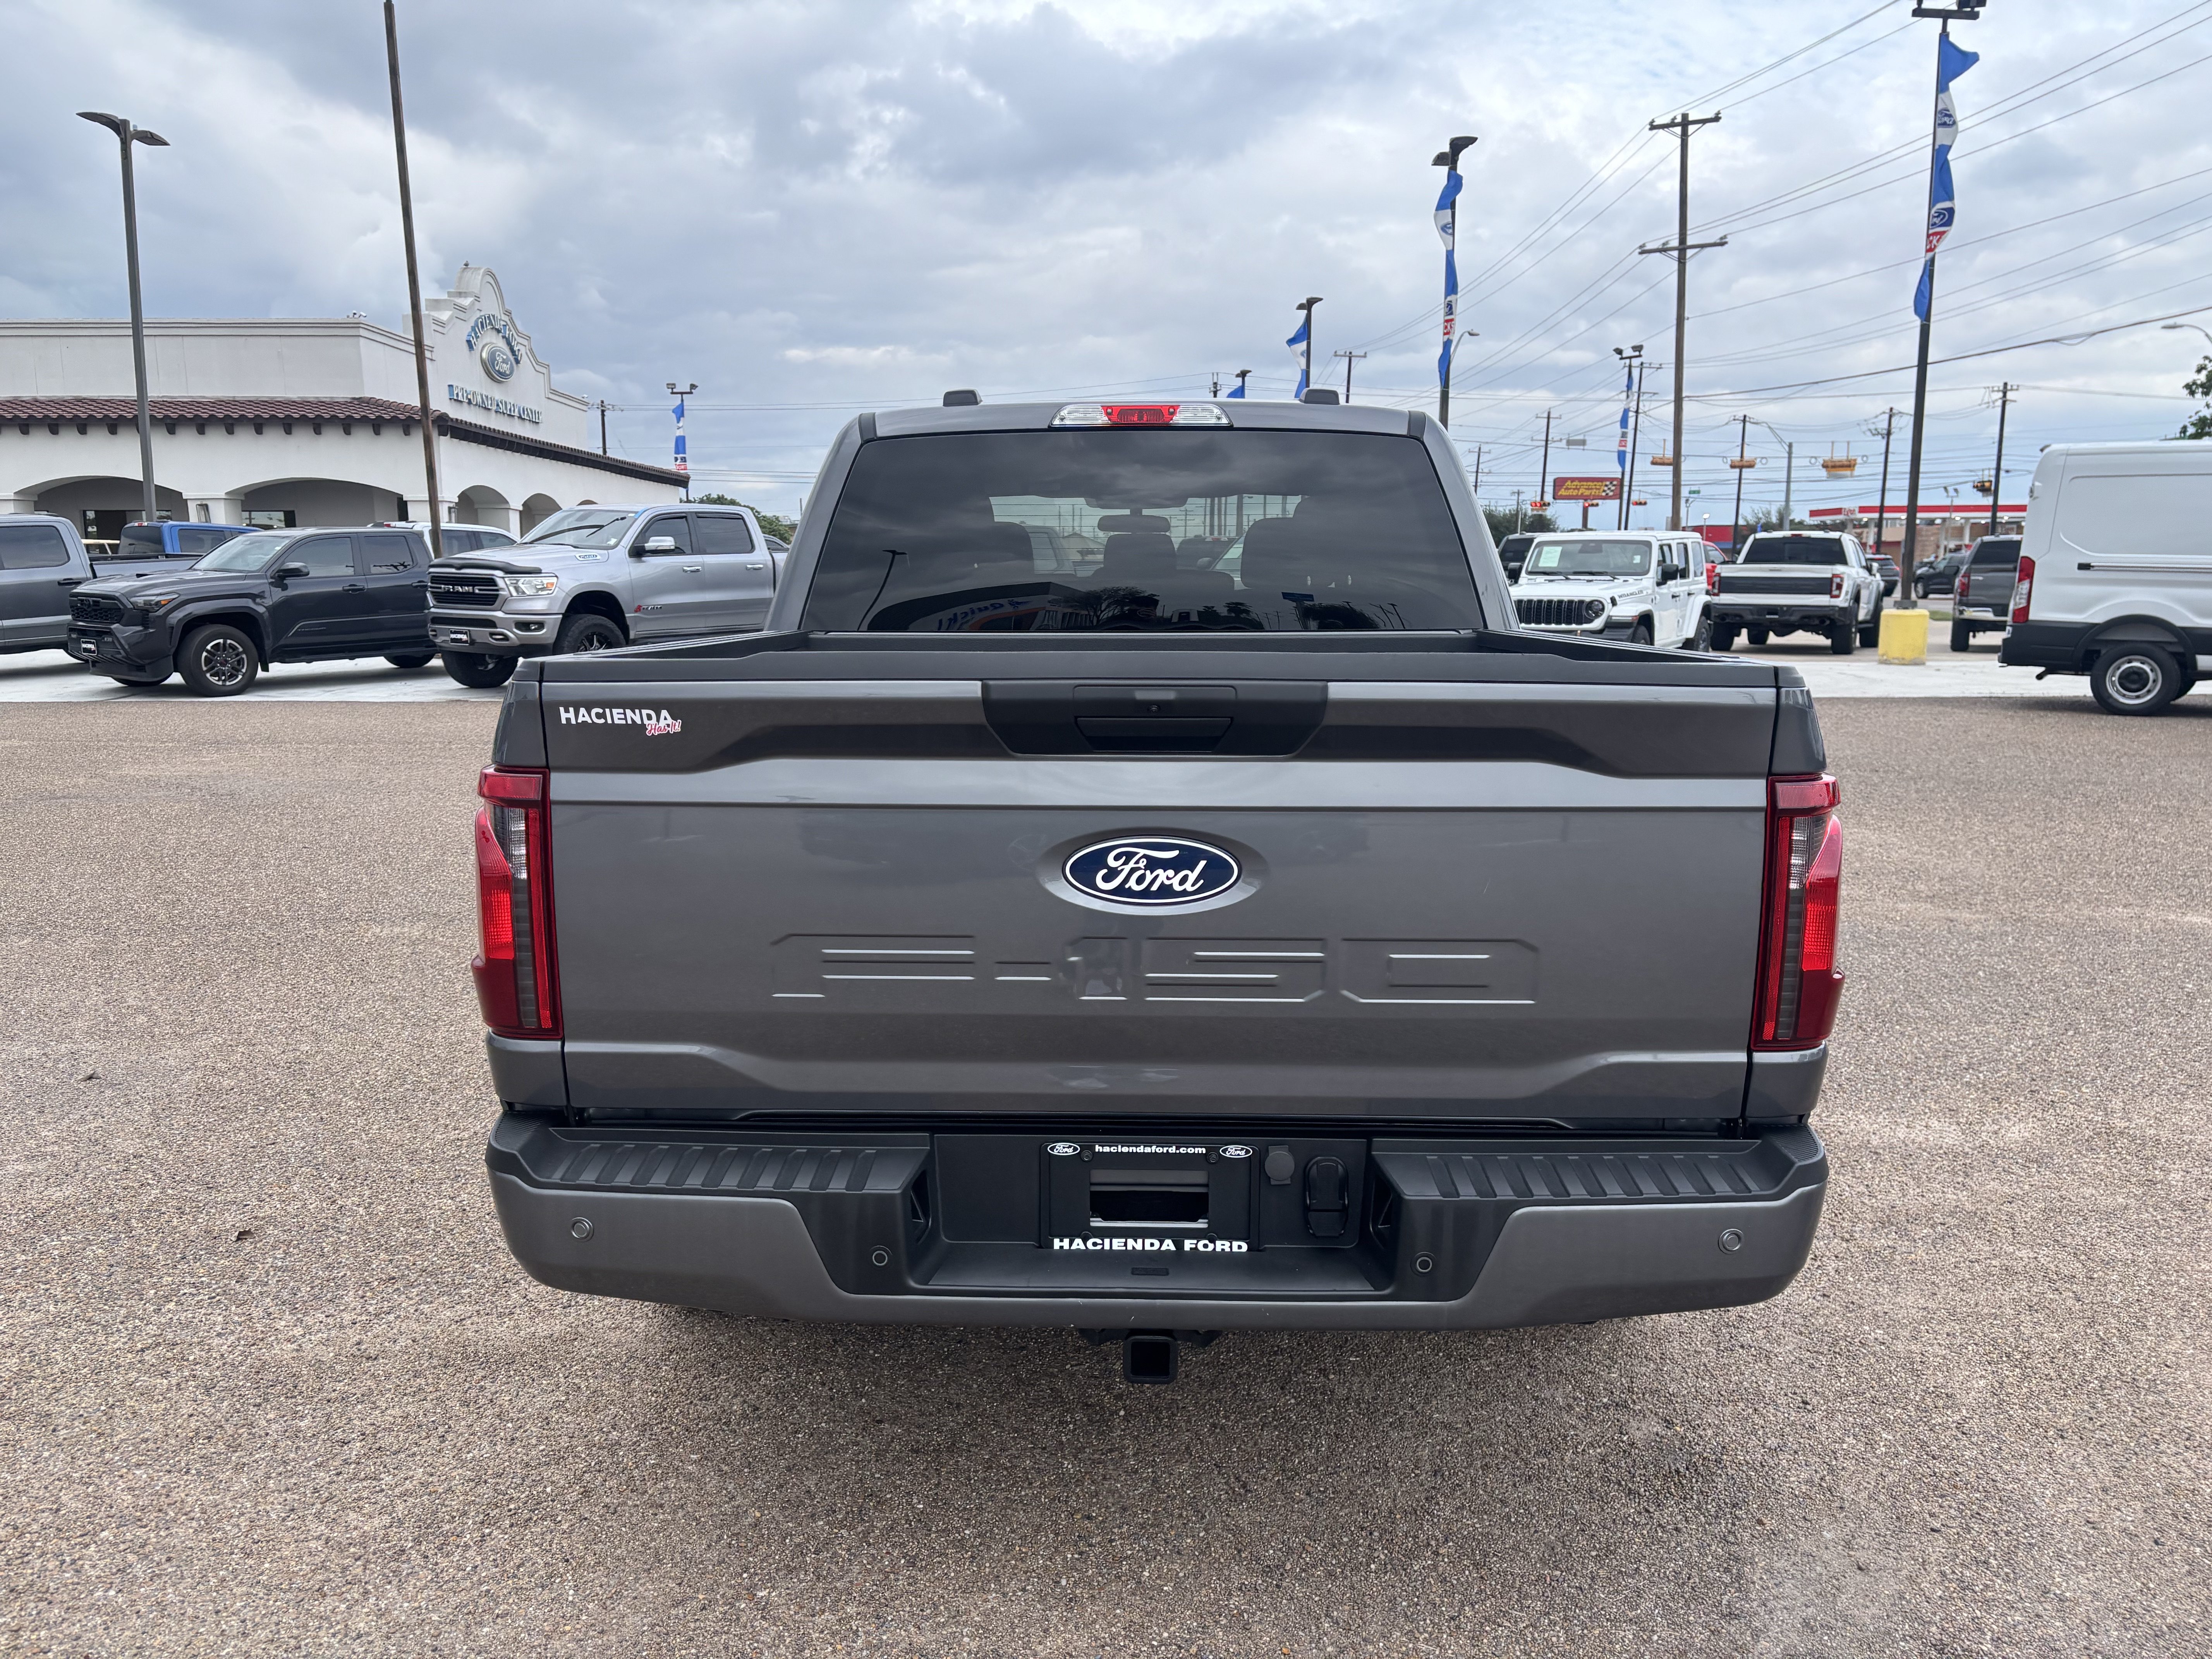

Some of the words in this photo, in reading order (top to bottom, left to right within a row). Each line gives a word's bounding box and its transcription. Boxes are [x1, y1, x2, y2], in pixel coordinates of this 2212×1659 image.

[467, 313, 503, 351] HACIENDA
[503, 325, 522, 364] FORD
[495, 352, 511, 374] Ford
[450, 385, 496, 410] PRE-OWNED
[1564, 480, 1602, 488] Advance
[1617, 590, 1644, 599] WRANGLER
[559, 707, 674, 726] HACIENDA
[646, 723, 666, 735] Has
[1096, 847, 1207, 892] Ford
[770, 933, 1538, 1005] F-150
[1053, 1145, 1074, 1154] Ford
[1095, 1145, 1206, 1154] haciendaford.com
[1226, 1147, 1246, 1156] Ford
[1053, 1238, 1176, 1251] HACIENDA
[1184, 1240, 1248, 1252] FORD
